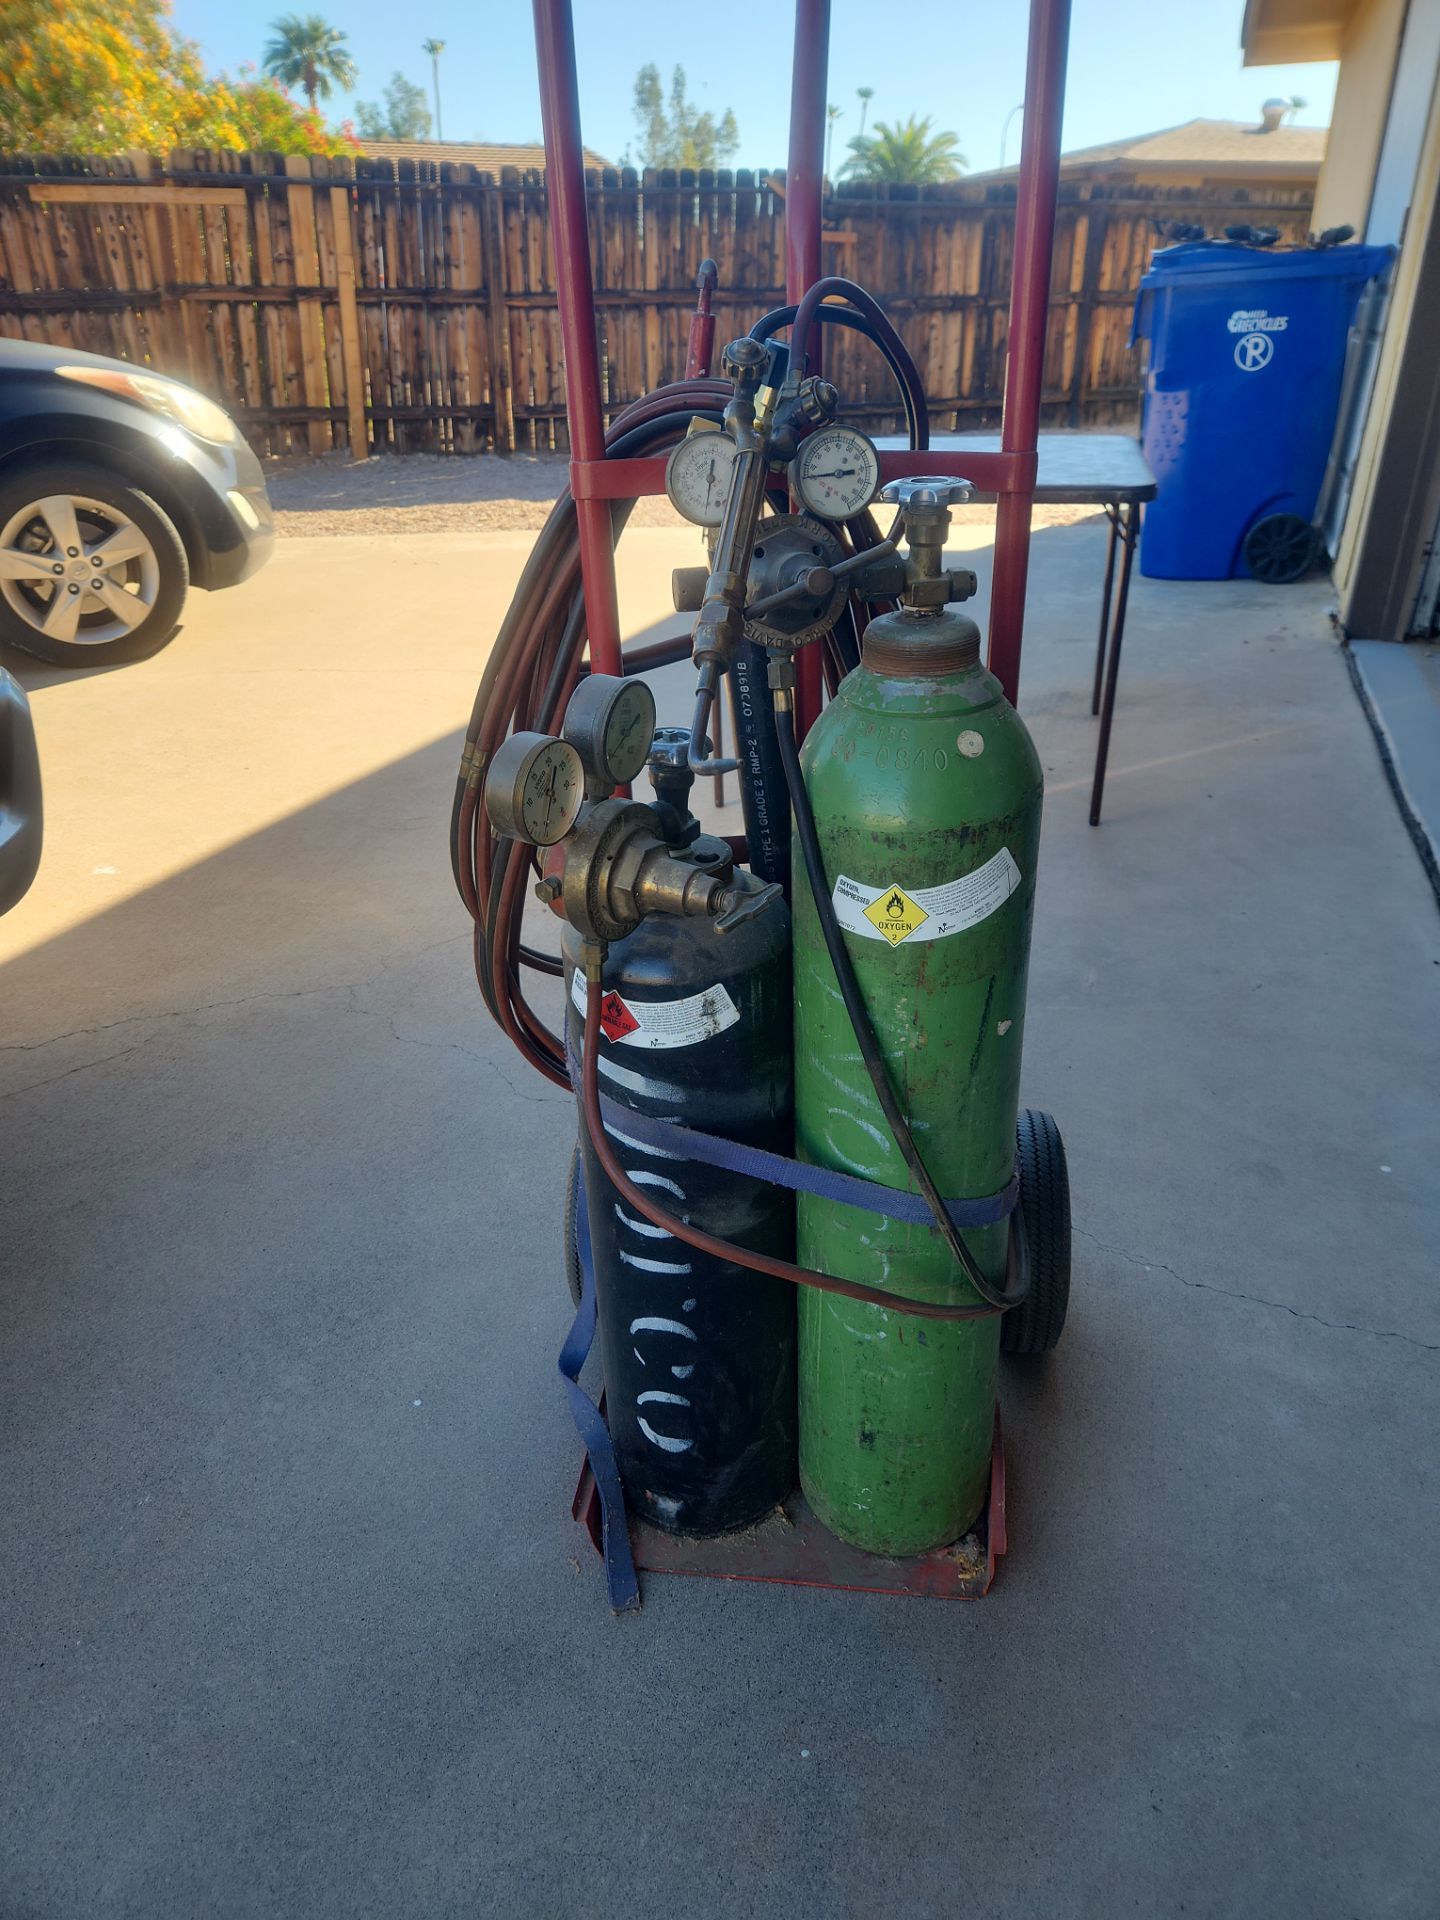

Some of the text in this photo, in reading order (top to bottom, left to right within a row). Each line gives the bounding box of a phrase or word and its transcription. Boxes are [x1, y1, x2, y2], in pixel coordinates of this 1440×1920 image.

[749, 738, 761, 775] RMP-2
[753, 779, 763, 787] 2
[754, 789, 768, 826] GRADE
[762, 837, 774, 865] TYPE
[836, 885, 870, 905] COMPRESSED
[878, 921, 912, 931] OXYGEN
